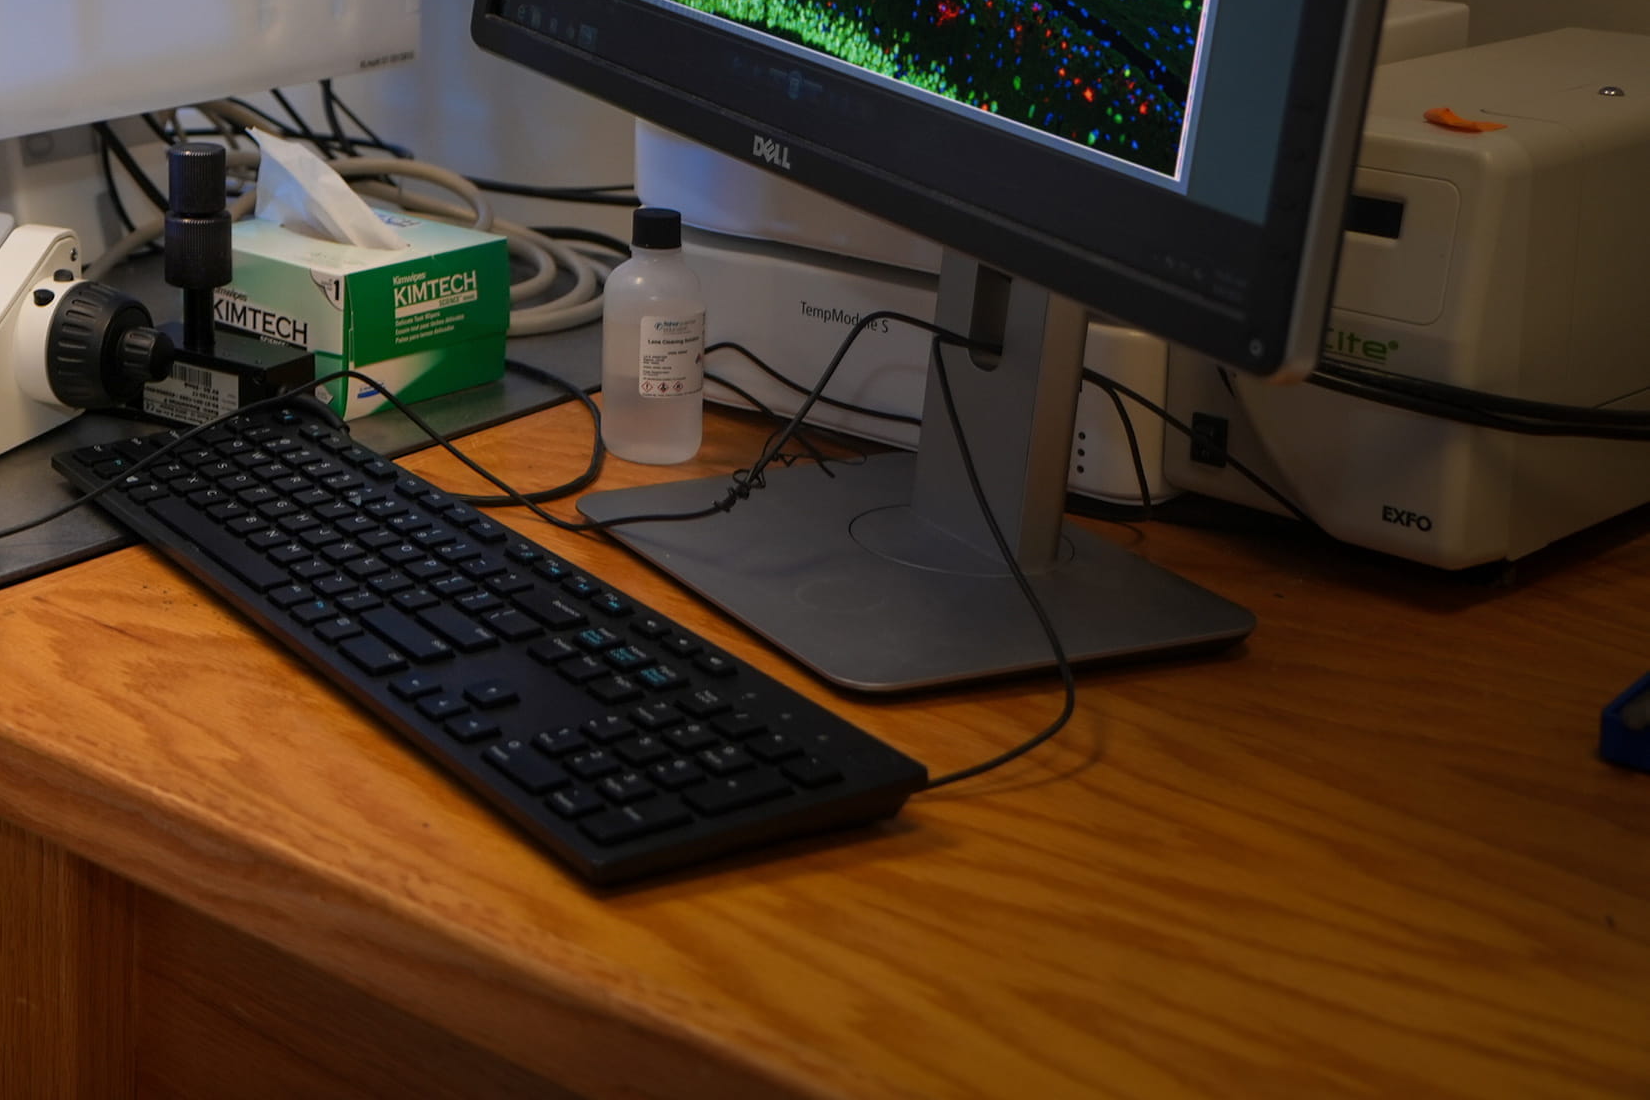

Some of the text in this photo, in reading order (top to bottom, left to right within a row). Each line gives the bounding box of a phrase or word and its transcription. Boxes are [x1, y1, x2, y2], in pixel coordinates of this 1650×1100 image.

[753, 135, 790, 170] DELL
[334, 279, 340, 301] 1
[393, 272, 426, 286] Kimwipes
[394, 270, 476, 308] KIMTECH
[213, 299, 308, 344] KIMTECH
[800, 300, 889, 333] TempMode S
[1382, 505, 1432, 532] EXFO
